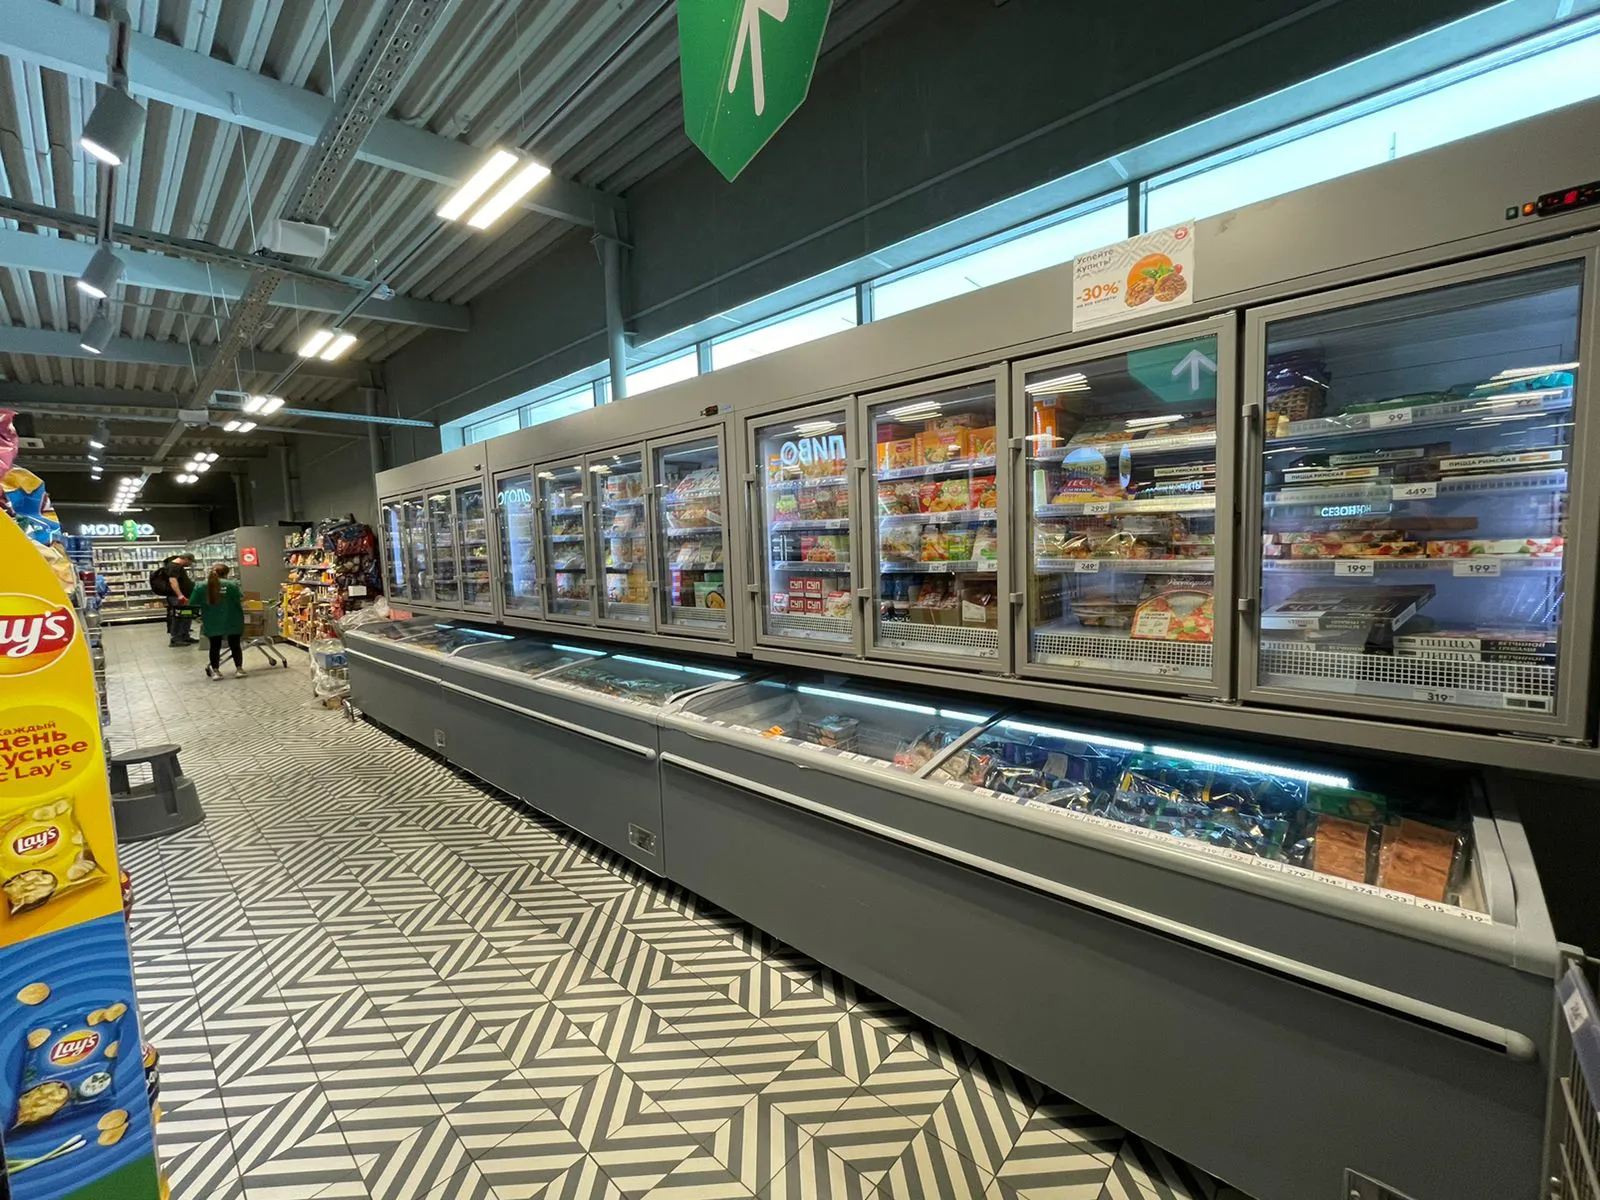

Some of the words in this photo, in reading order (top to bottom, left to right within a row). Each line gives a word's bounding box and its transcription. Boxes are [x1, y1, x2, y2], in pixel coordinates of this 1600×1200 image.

[1077, 249, 1113, 264] Успейте
[1405, 487, 1427, 495] 449
[1347, 564, 1367, 573] 199
[1469, 564, 1491, 572] 199
[1427, 692, 1448, 702] 319
[15, 759, 72, 780] Lay's
[17, 826, 57, 854] Lay's
[55, 1035, 98, 1059] Lay's
